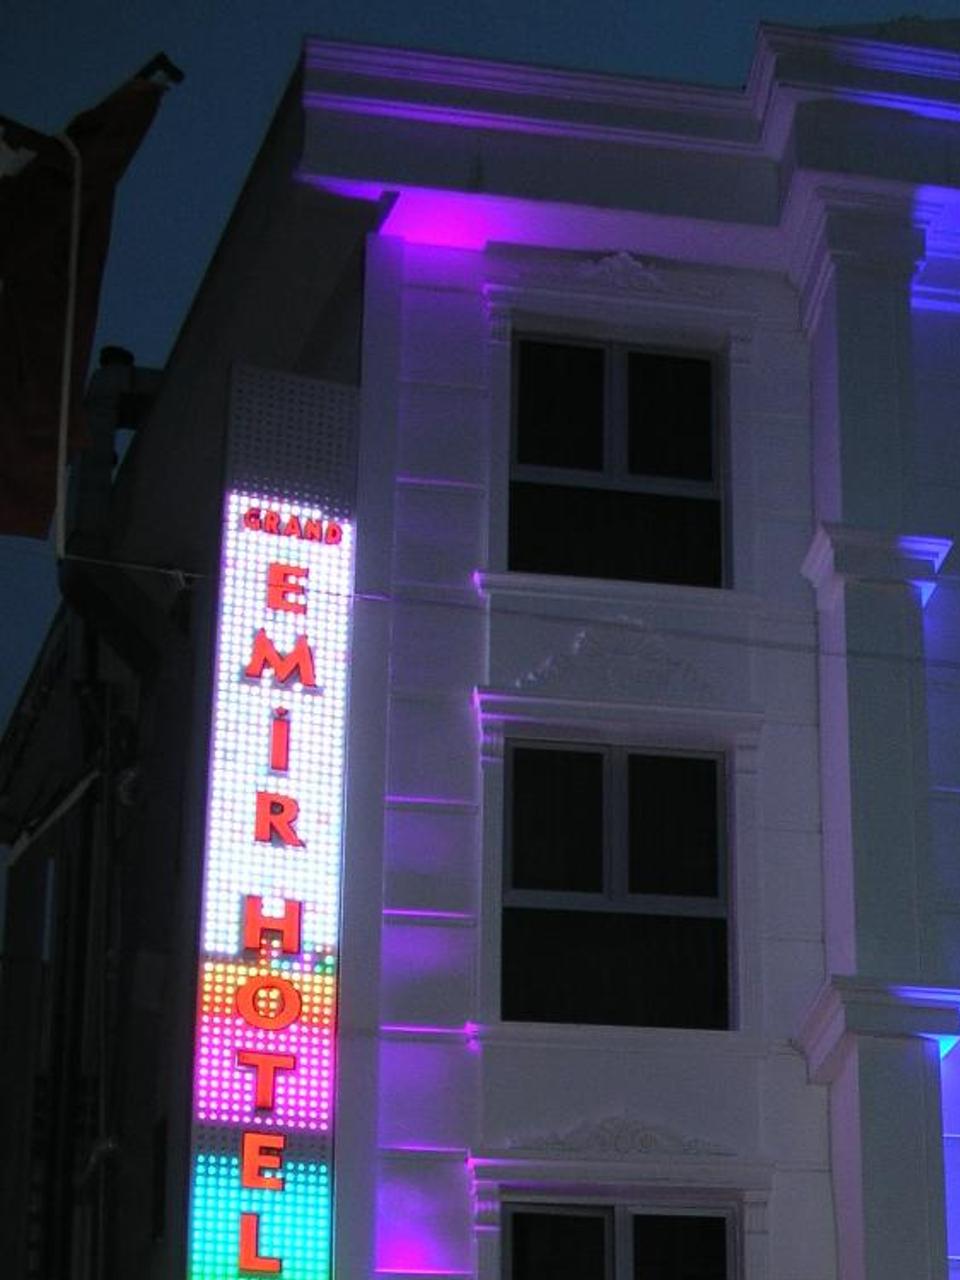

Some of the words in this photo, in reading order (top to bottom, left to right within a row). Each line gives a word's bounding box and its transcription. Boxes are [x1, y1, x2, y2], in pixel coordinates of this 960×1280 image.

[243, 507, 343, 545] GRAND
[244, 561, 317, 848] EMİR
[236, 895, 303, 1275] HOTEL
